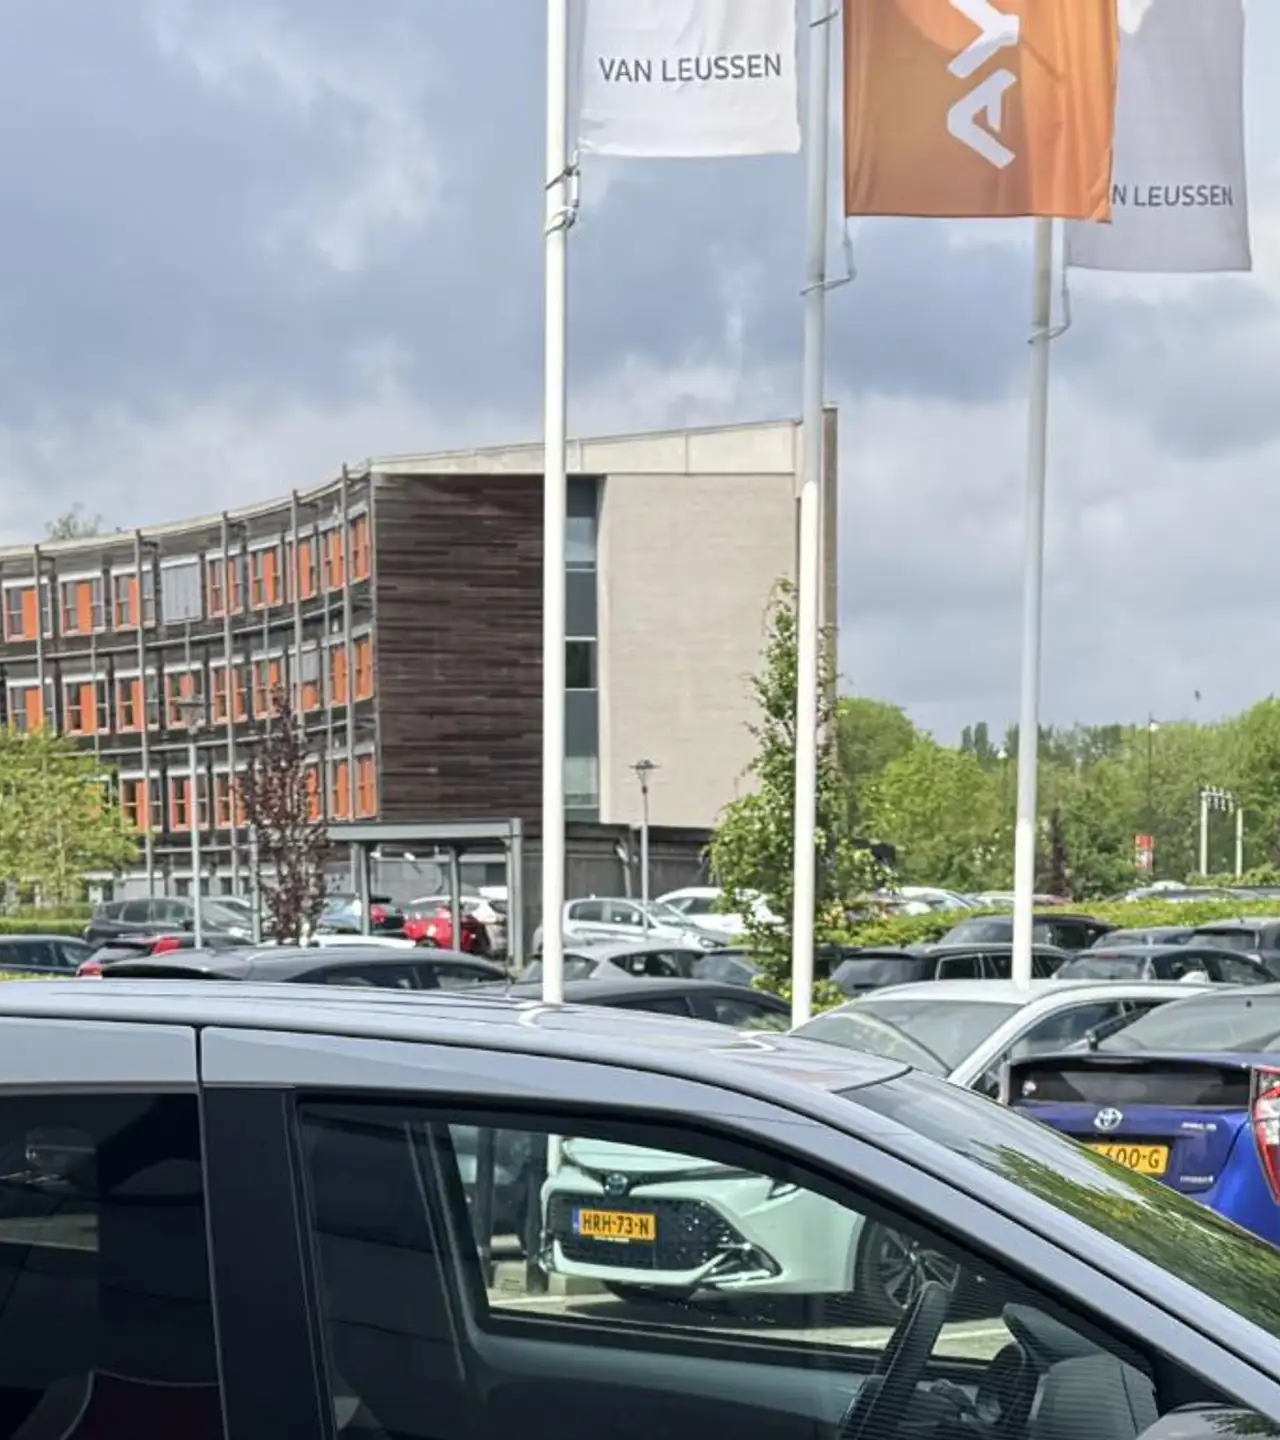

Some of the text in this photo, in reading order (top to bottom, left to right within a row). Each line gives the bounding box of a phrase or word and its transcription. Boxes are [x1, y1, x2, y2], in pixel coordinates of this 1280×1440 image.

[598, 53, 782, 83] VAN LEUSSEN
[1133, 184, 1234, 206] LEUSSEN
[582, 1213, 650, 1237] HRH-73-N
